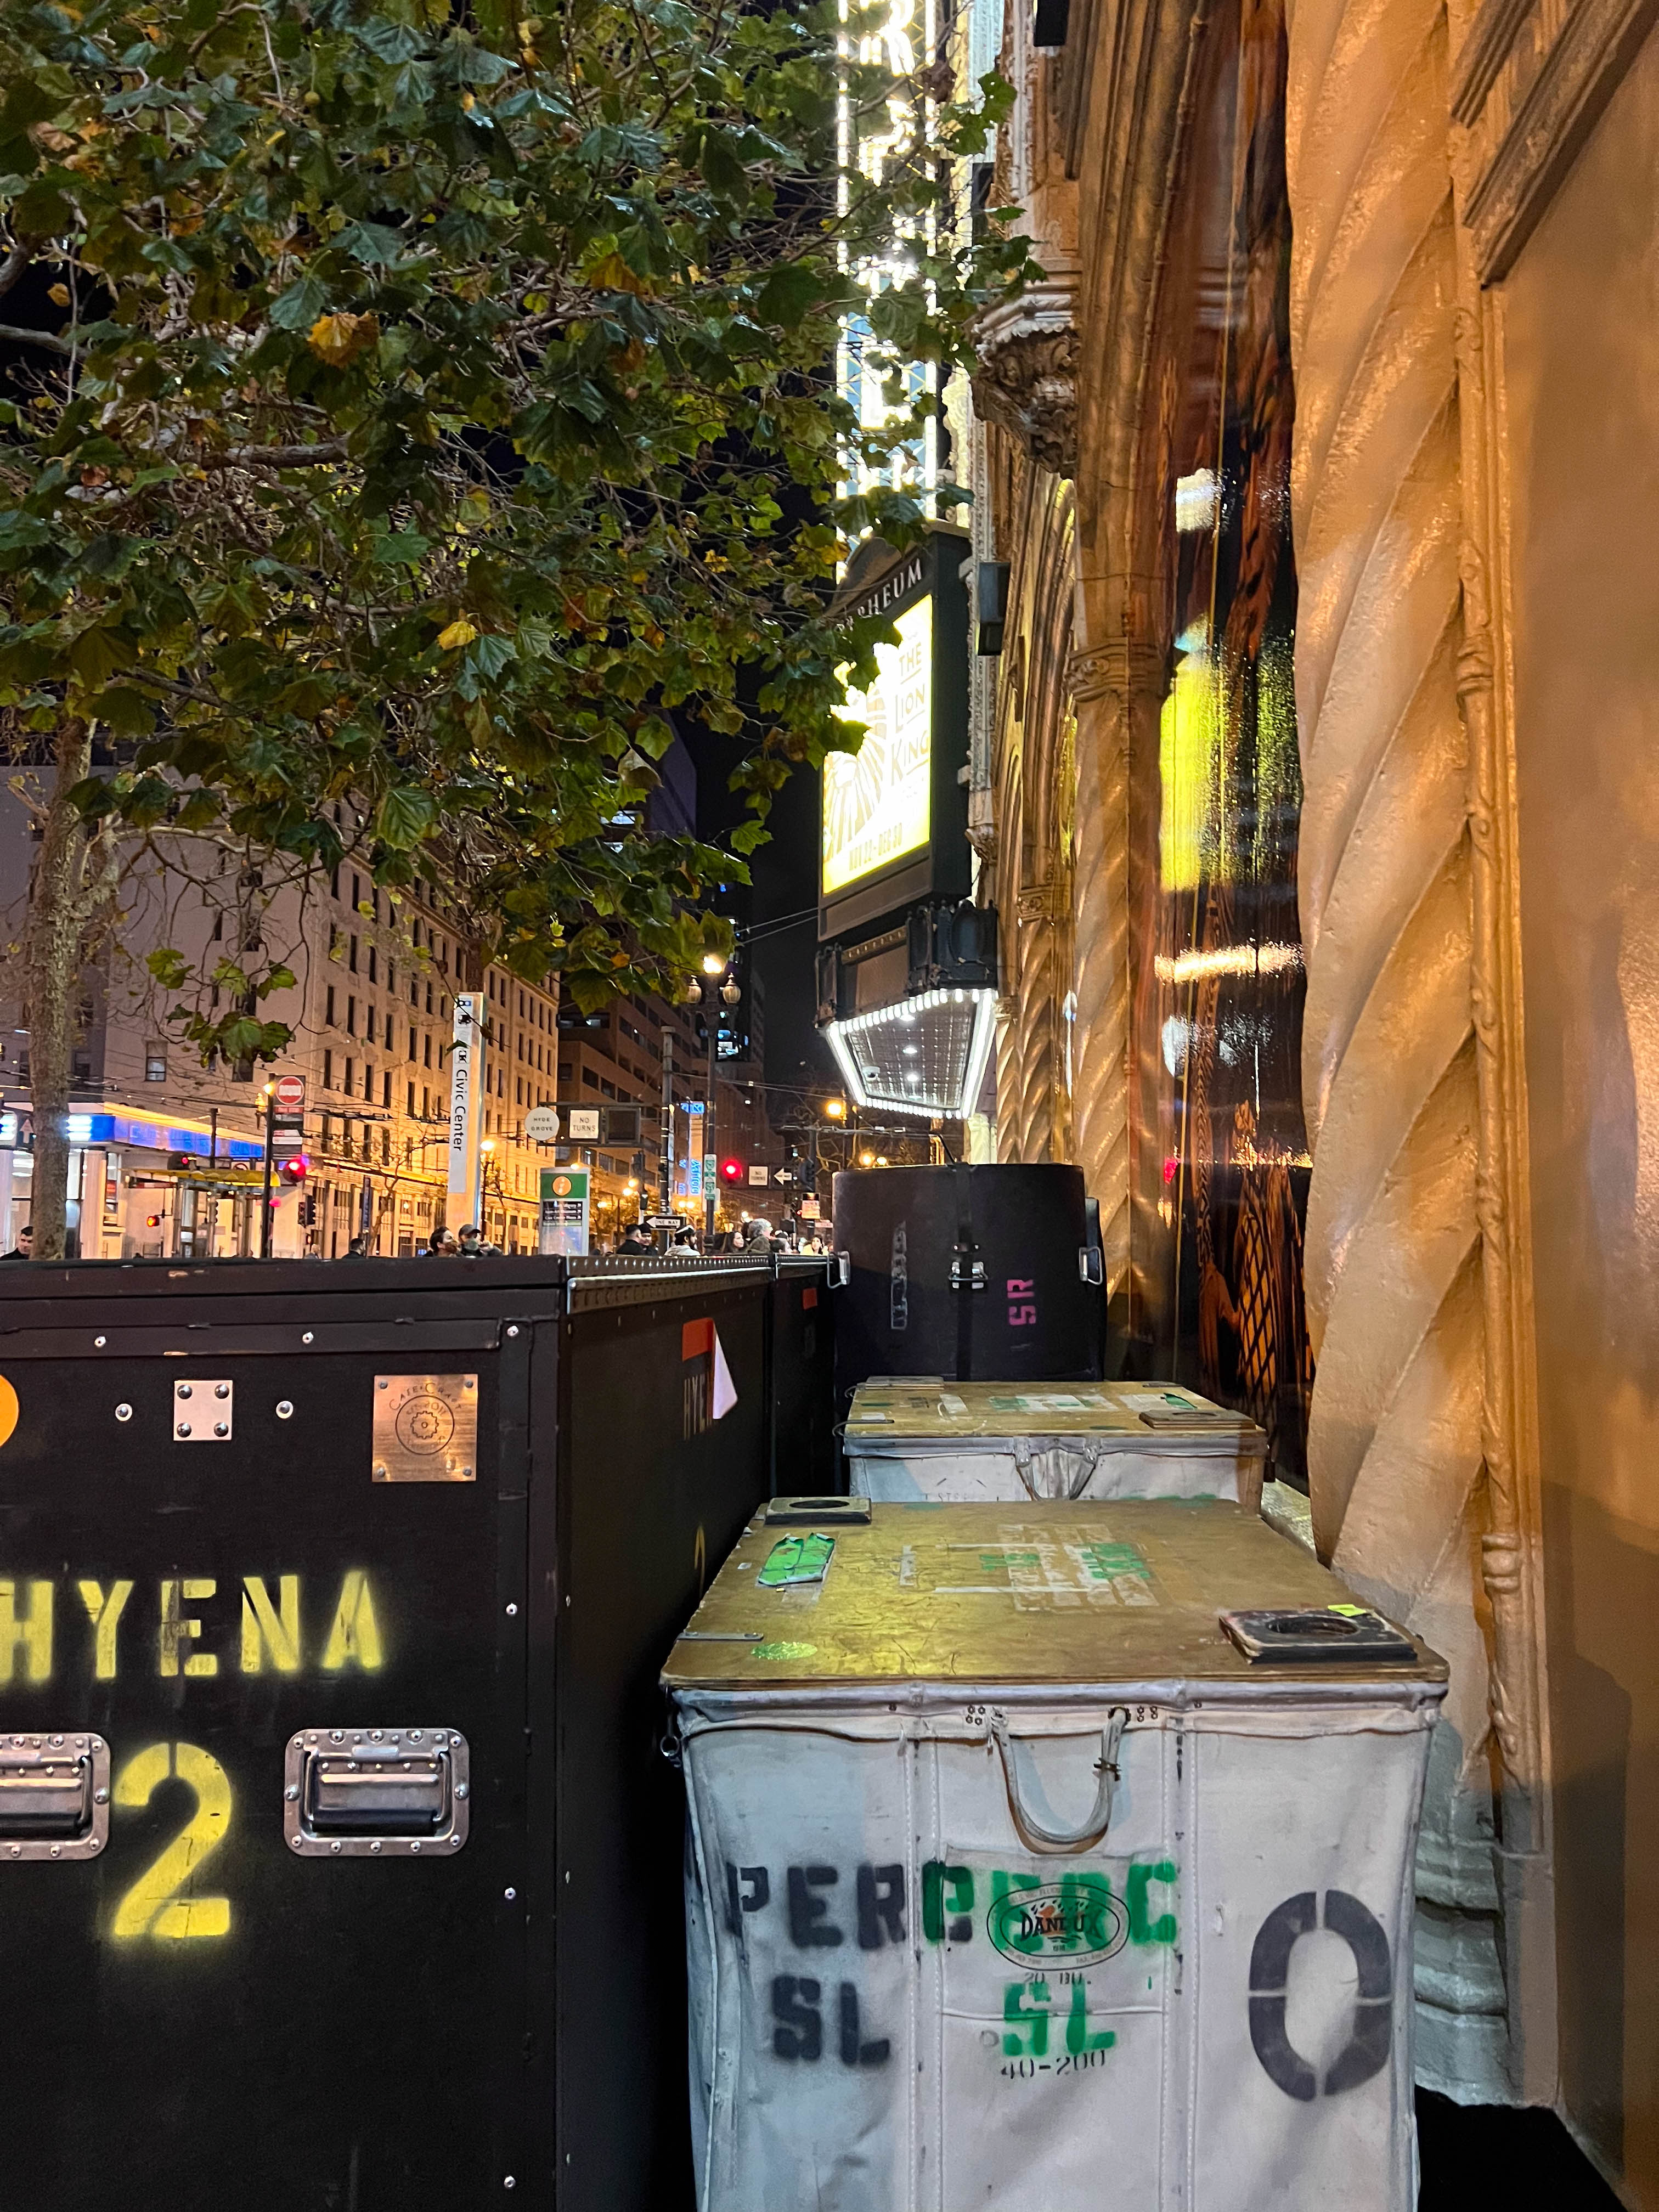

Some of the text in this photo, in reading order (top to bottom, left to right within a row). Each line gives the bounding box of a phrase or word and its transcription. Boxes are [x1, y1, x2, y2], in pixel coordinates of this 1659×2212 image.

[899, 642, 922, 676] THE
[895, 684, 925, 734] LION
[891, 729, 930, 786] KING
[453, 1069, 467, 1152] Civic Center
[0, 1570, 383, 1680] HYENA
[114, 1742, 232, 1938] 2
[772, 1975, 890, 2066] SL
[1003, 1981, 1117, 2056] SL
